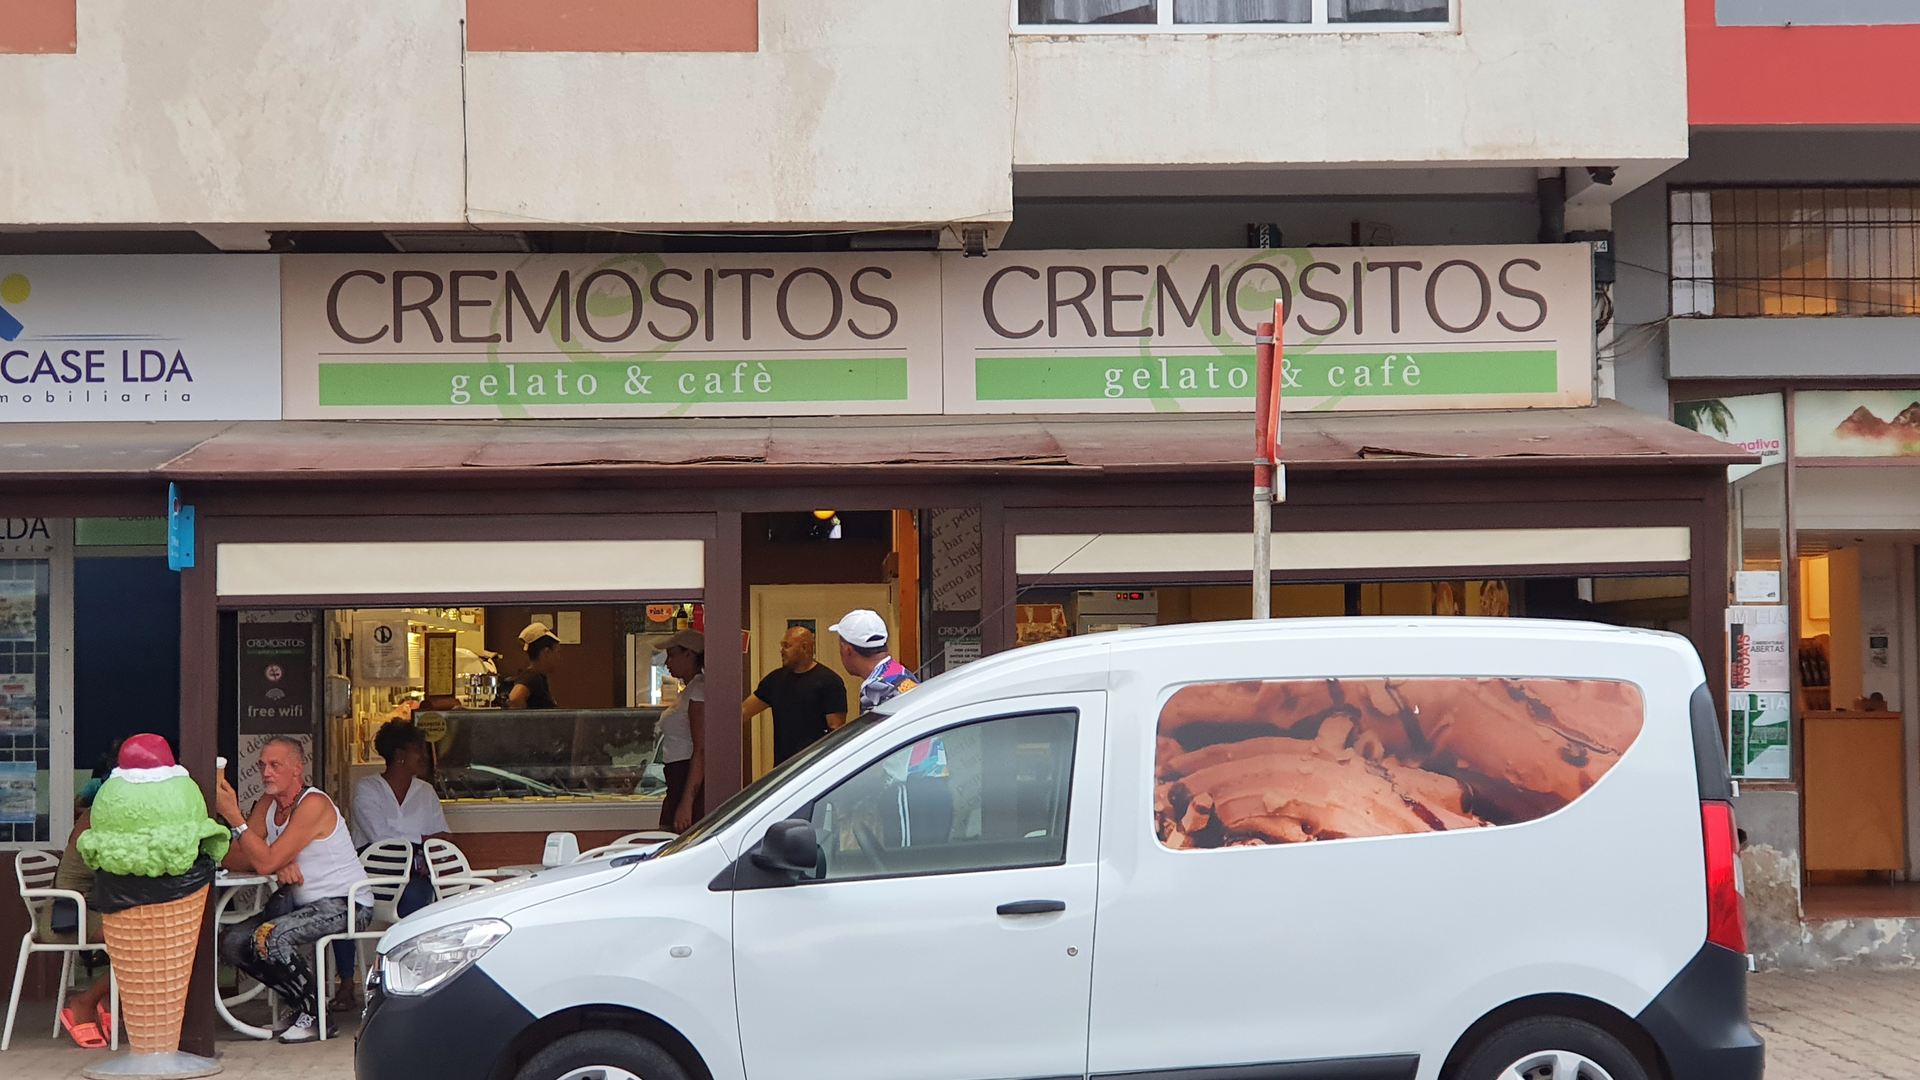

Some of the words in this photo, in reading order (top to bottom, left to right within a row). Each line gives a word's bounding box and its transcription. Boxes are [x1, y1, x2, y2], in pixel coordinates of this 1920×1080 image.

[326, 266, 899, 344] CREMOSITOS
[982, 258, 1548, 338] CREMOSITOS
[1, 349, 105, 384] CASE
[122, 349, 194, 383] LDA
[450, 364, 598, 404] gelato
[624, 367, 654, 395] &
[678, 361, 773, 395] cafè
[1104, 357, 1250, 398] gelato
[1280, 360, 1303, 388] &
[1327, 354, 1422, 387] cafè
[0, 517, 50, 540] DA
[246, 638, 306, 648] CREMOSITOS
[1737, 634, 1751, 689] VISUAIS
[1750, 645, 1785, 653] ABERTAS
[247, 705, 275, 717] free
[278, 704, 303, 717] wifi
